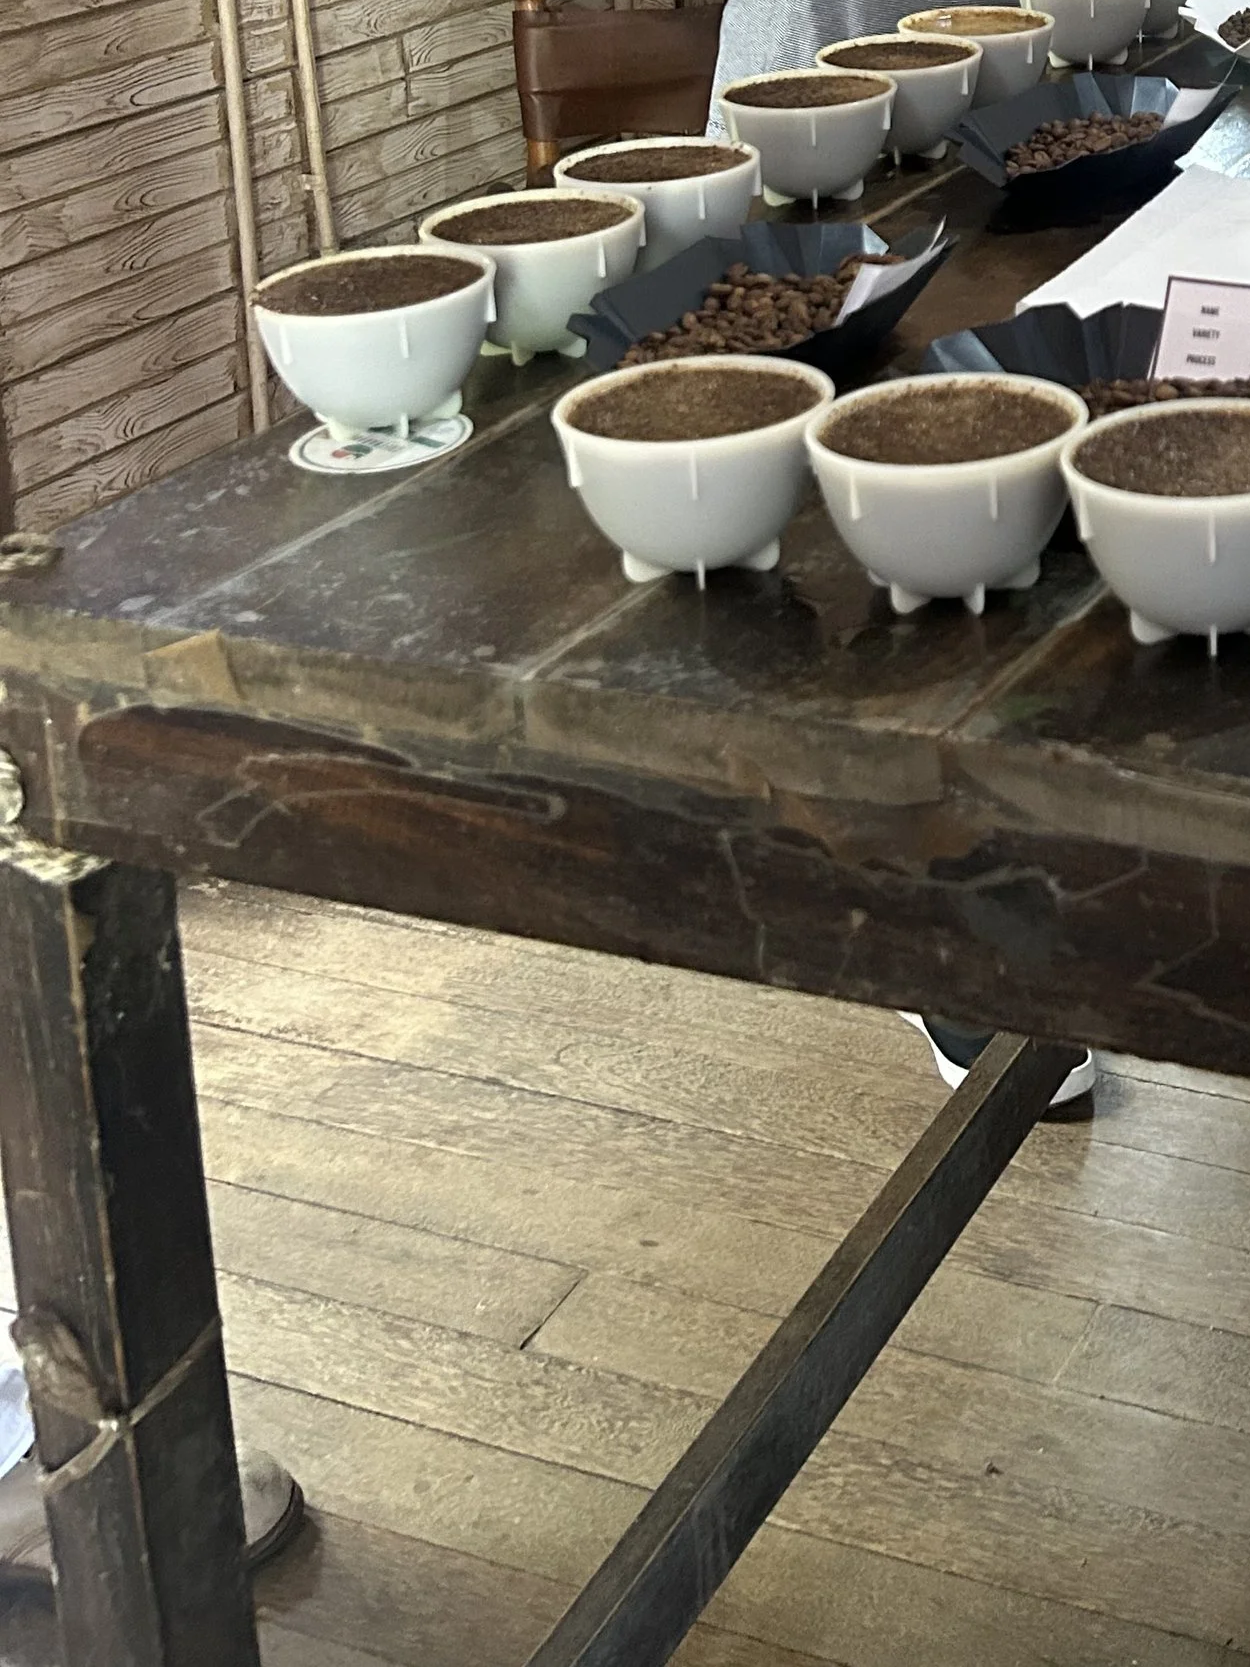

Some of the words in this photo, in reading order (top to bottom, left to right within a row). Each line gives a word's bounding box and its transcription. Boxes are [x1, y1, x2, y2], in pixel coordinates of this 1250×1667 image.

[1201, 305, 1220, 317] NAME
[1192, 327, 1220, 340] VARIETY
[1186, 353, 1217, 366] PROCESS
